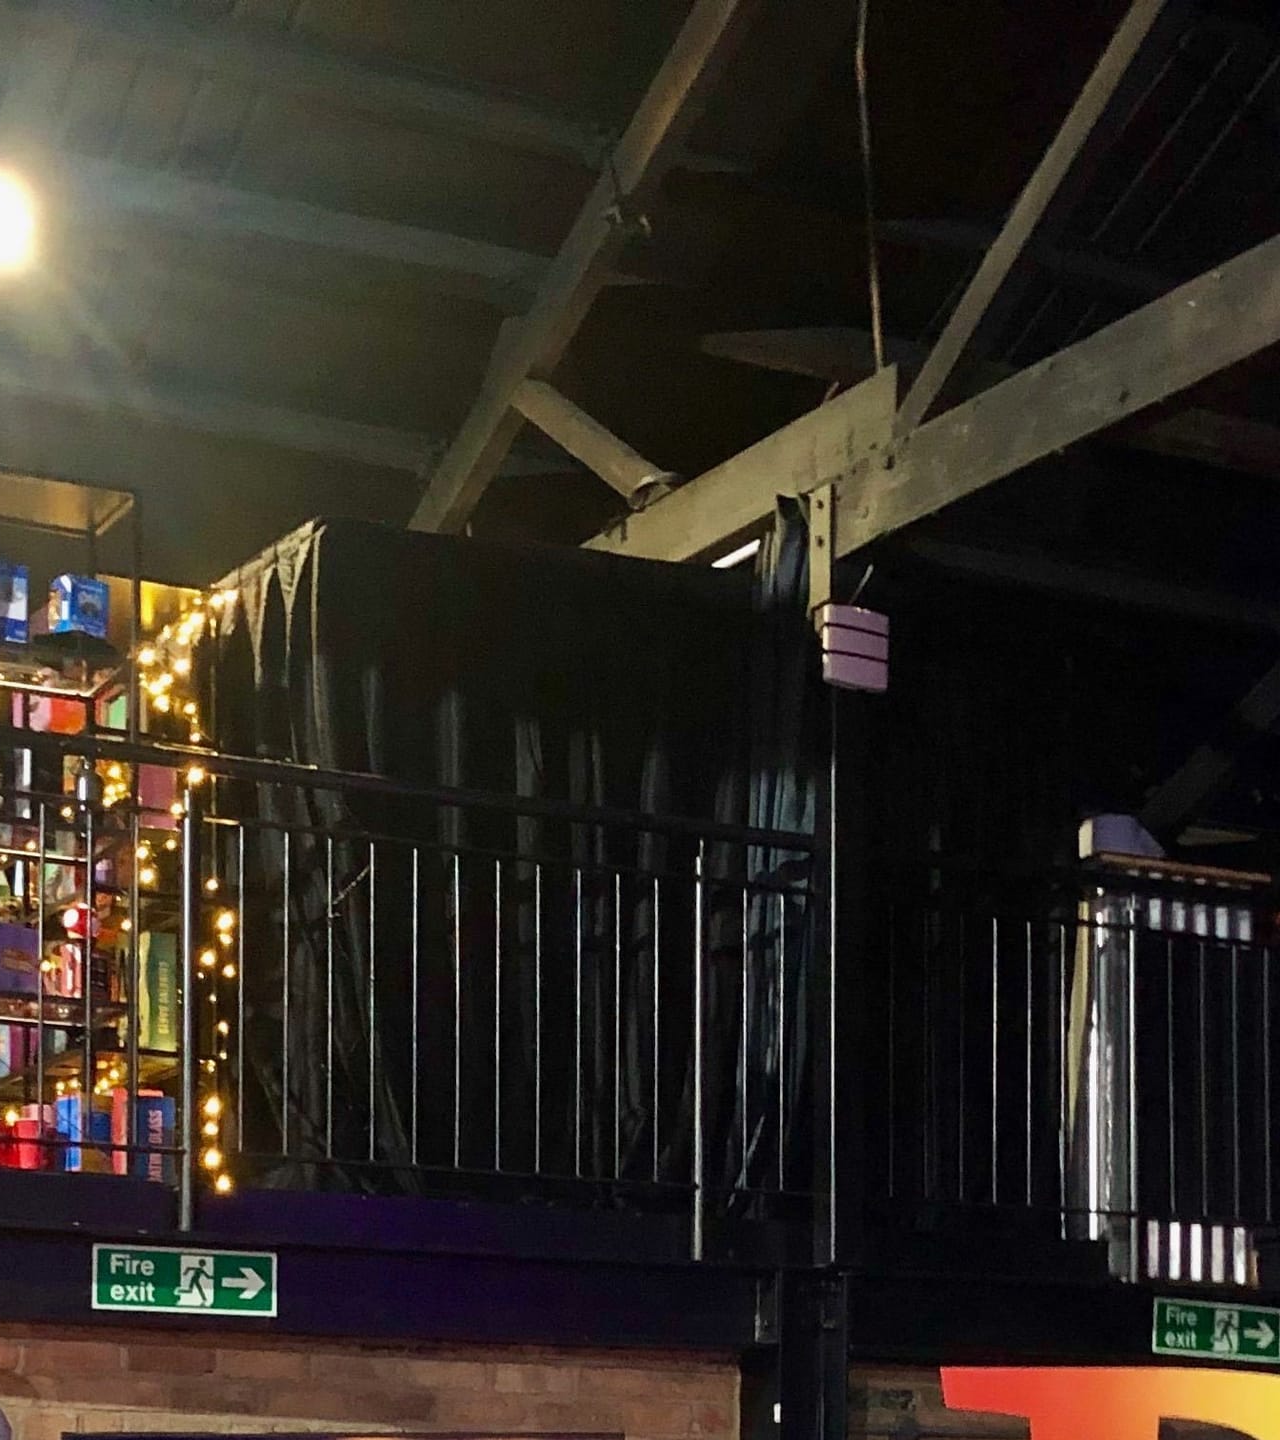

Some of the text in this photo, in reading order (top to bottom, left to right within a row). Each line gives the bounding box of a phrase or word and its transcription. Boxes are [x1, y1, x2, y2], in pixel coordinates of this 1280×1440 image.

[109, 1253, 155, 1277] Fire
[109, 1282, 156, 1303] exit
[1165, 1305, 1198, 1327] Fire
[1164, 1329, 1197, 1349] exit
